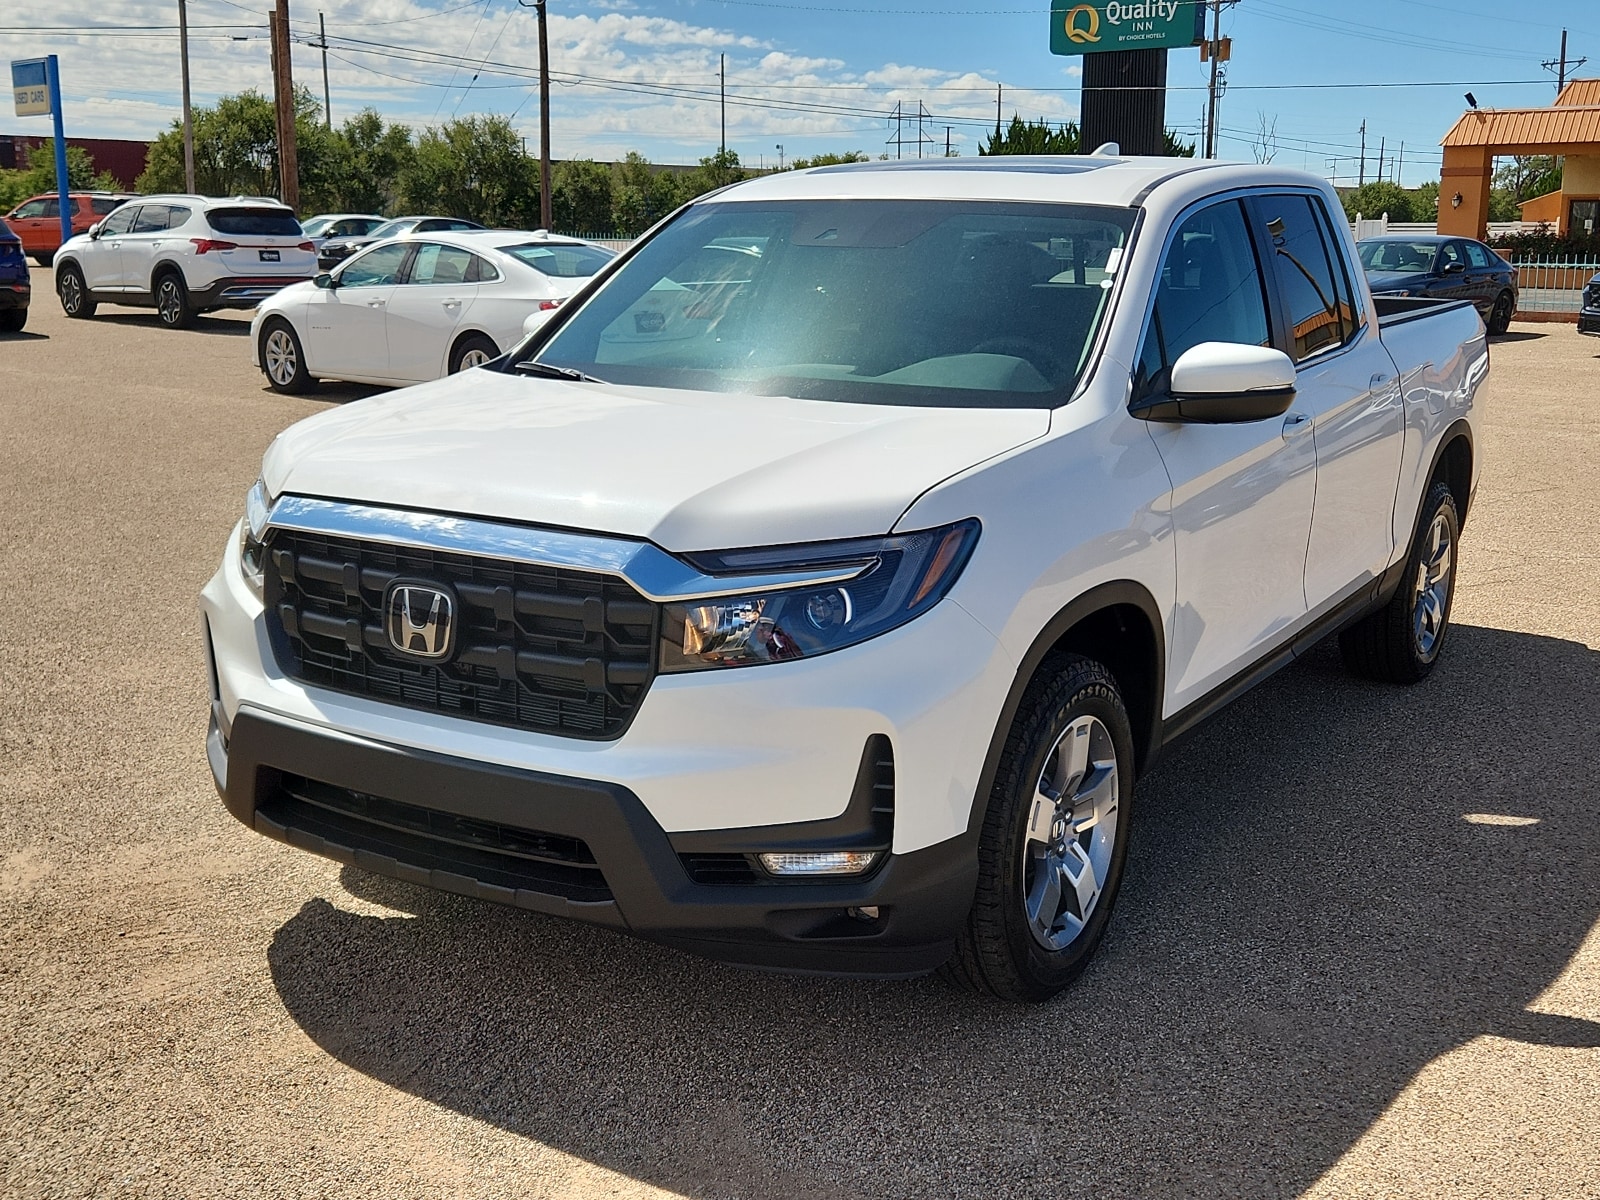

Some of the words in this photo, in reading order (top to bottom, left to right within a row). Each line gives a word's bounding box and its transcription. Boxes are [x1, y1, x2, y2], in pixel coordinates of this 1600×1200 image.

[1106, 0, 1178, 25] Quality
[1132, 21, 1153, 32] INN
[30, 90, 45, 103] CARS
